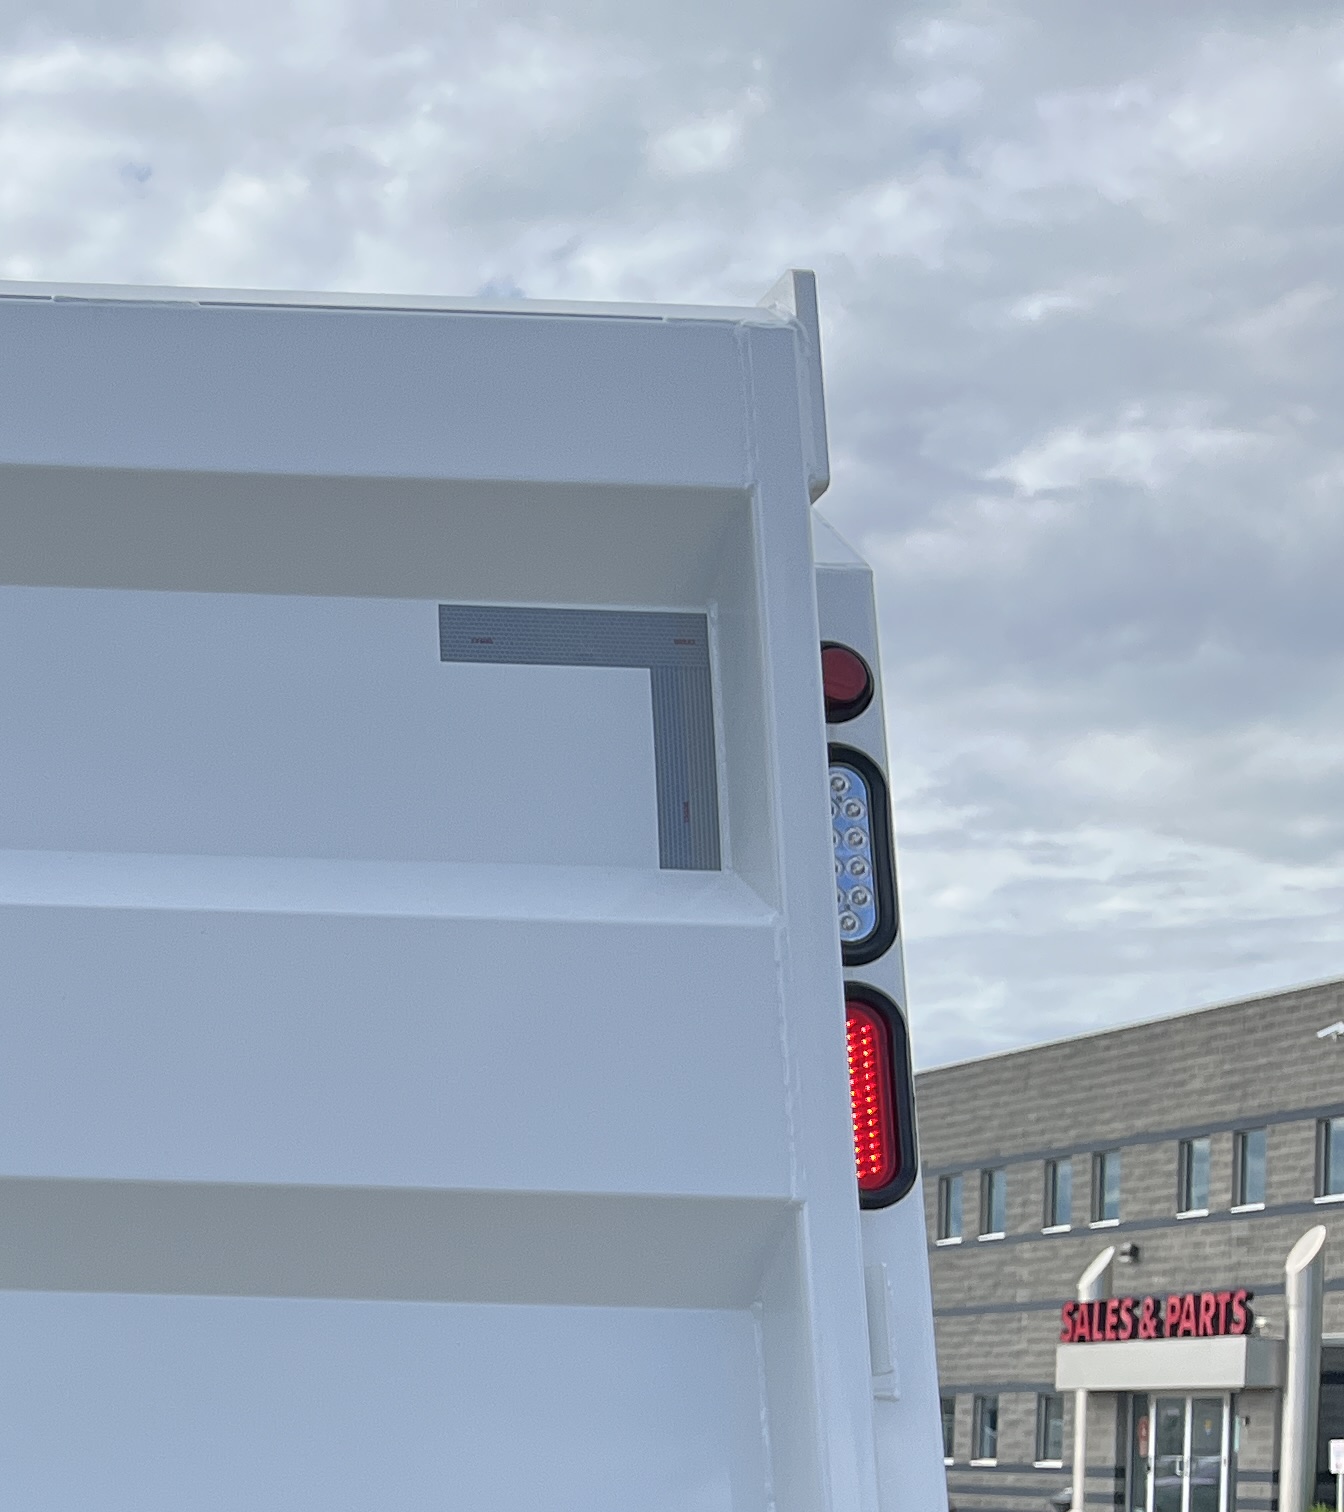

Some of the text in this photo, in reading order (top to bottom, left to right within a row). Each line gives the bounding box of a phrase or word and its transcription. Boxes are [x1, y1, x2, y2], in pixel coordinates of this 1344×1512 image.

[1060, 1288, 1250, 1343] SALES & PARTS
